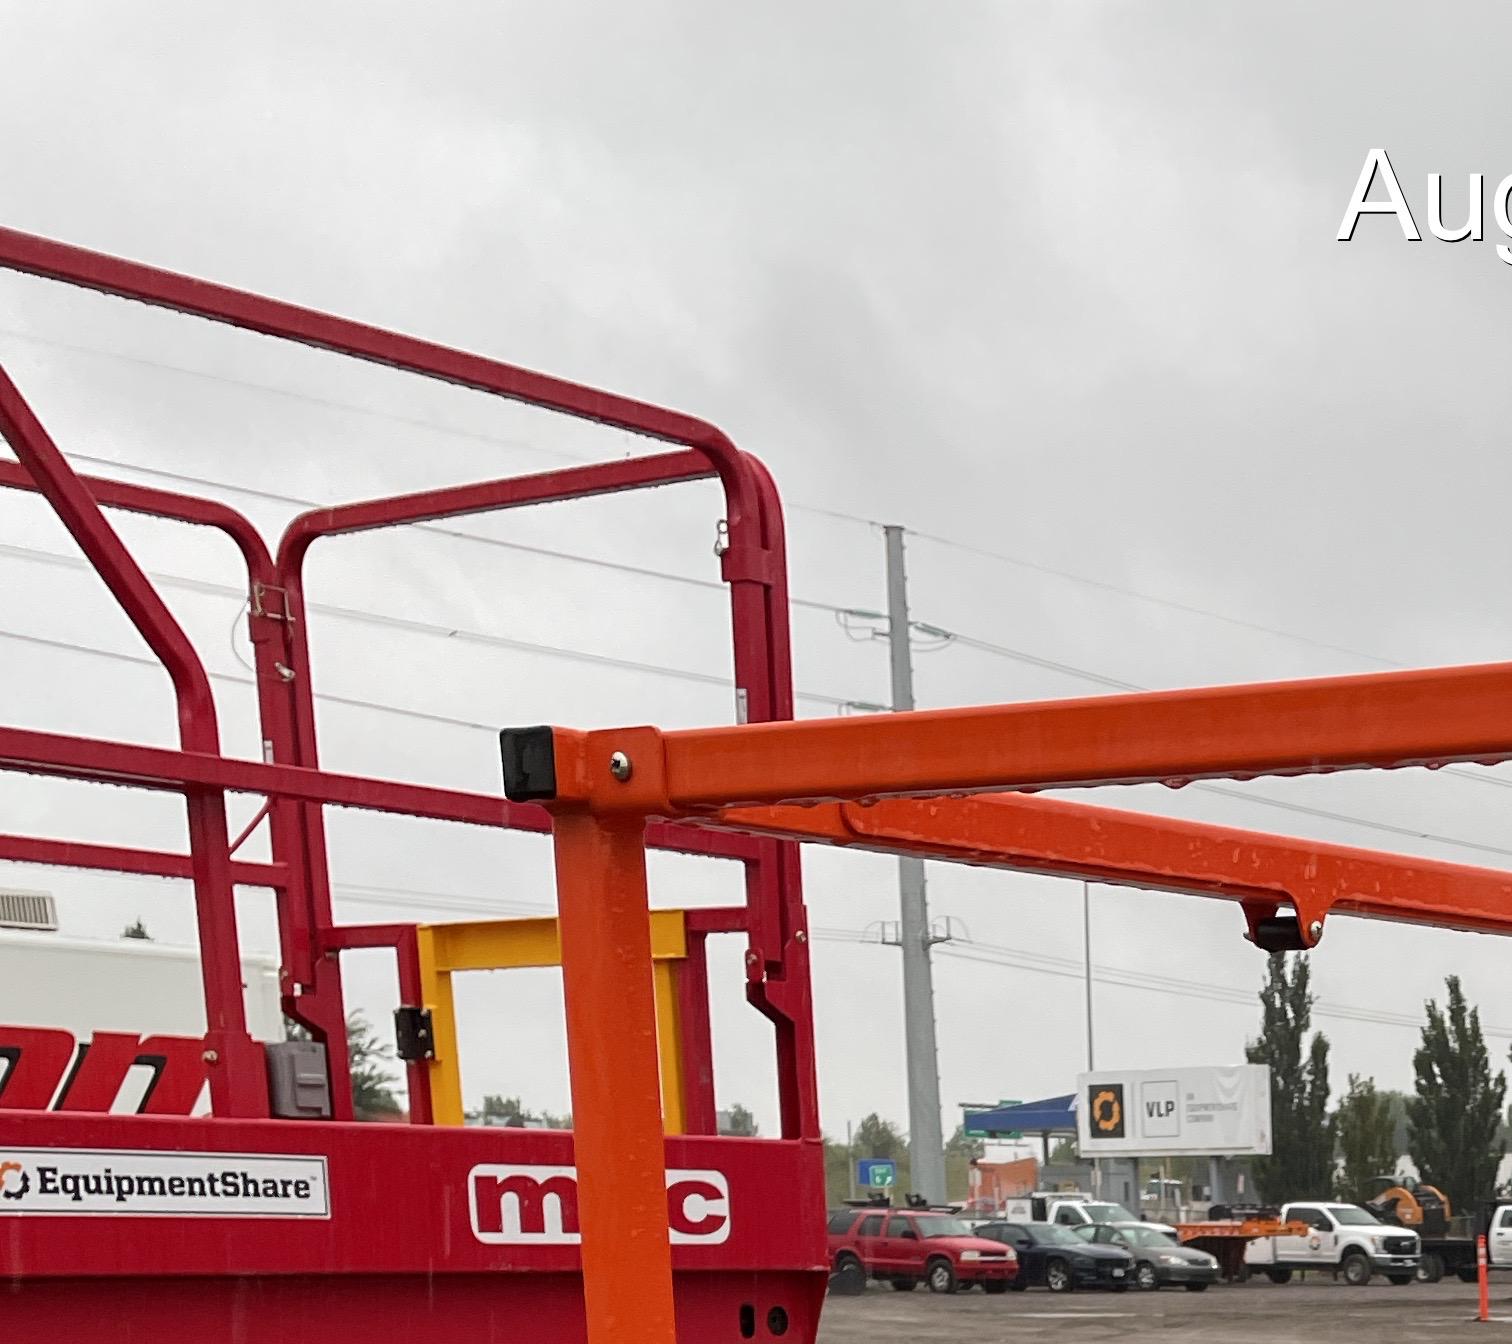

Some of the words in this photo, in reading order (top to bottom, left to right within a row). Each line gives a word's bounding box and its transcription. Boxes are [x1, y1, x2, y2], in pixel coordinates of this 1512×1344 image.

[1145, 1101, 1175, 1118] VLP
[36, 1166, 311, 1202] EquipmentShare
[475, 1174, 728, 1236] mc
